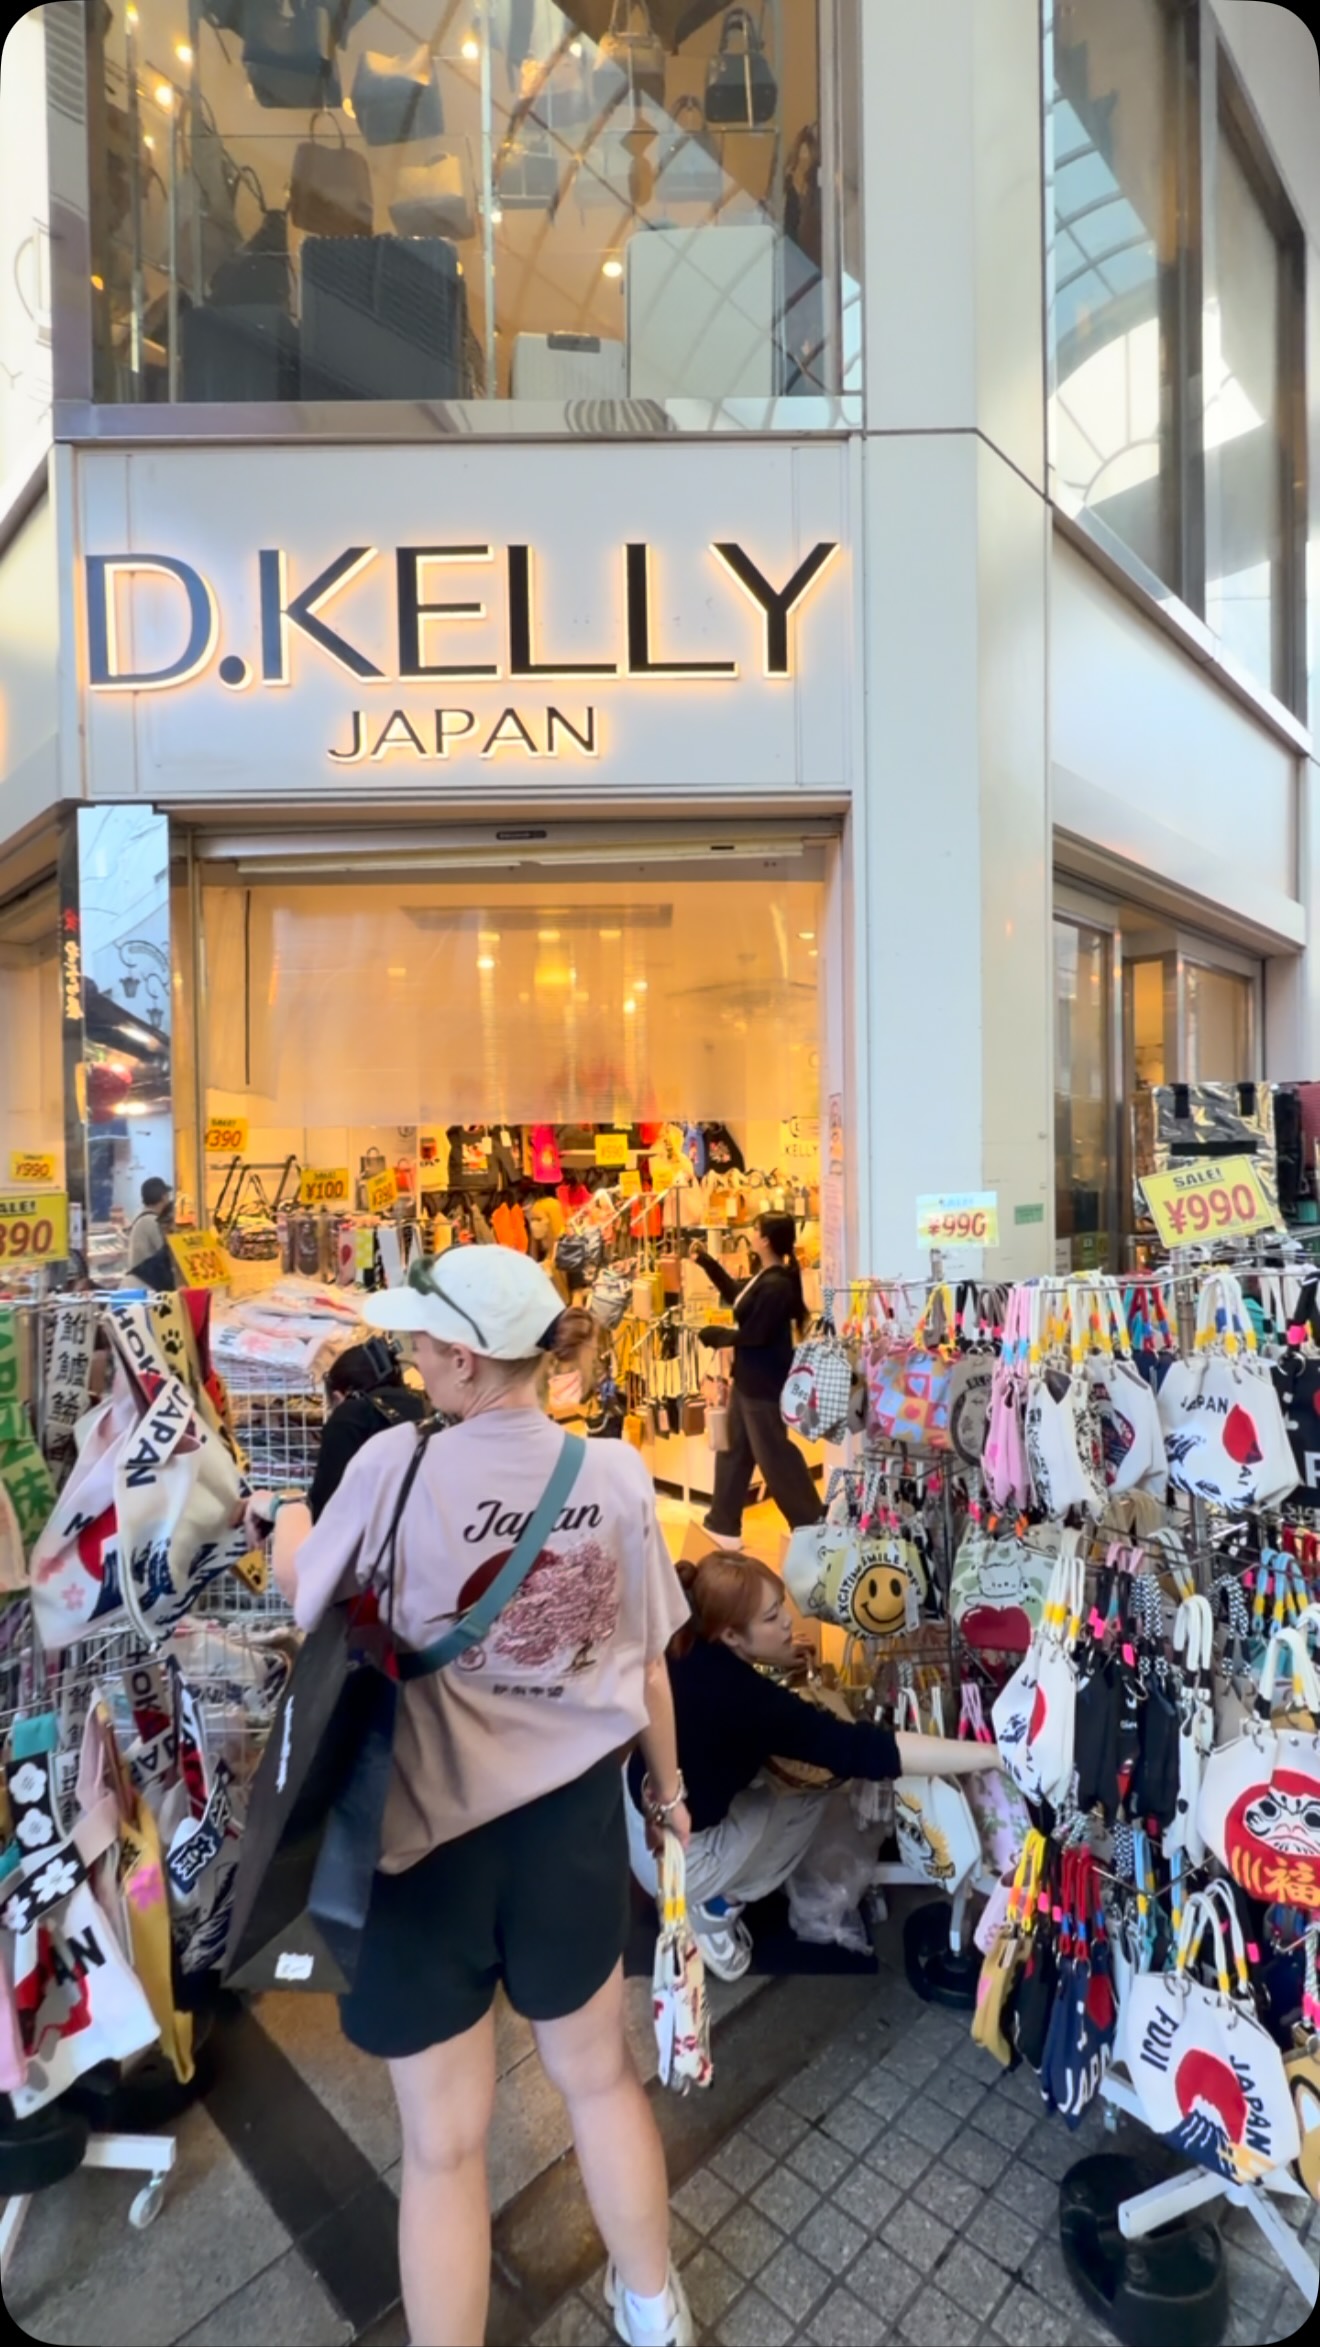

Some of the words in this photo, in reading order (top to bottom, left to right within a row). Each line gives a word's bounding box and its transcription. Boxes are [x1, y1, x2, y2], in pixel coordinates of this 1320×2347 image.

[85, 542, 839, 691] D.KELLY
[328, 706, 599, 762] JAPAN
[305, 1181, 344, 1199] ¥100
[1172, 1167, 1222, 1188] SALE!
[1163, 1184, 1256, 1235] ¥990
[125, 1383, 188, 1489] JAPAN
[463, 1499, 604, 1545] Jaan
[1139, 2004, 1180, 2072] FUJI
[1229, 2055, 1271, 2156] JAPAN
